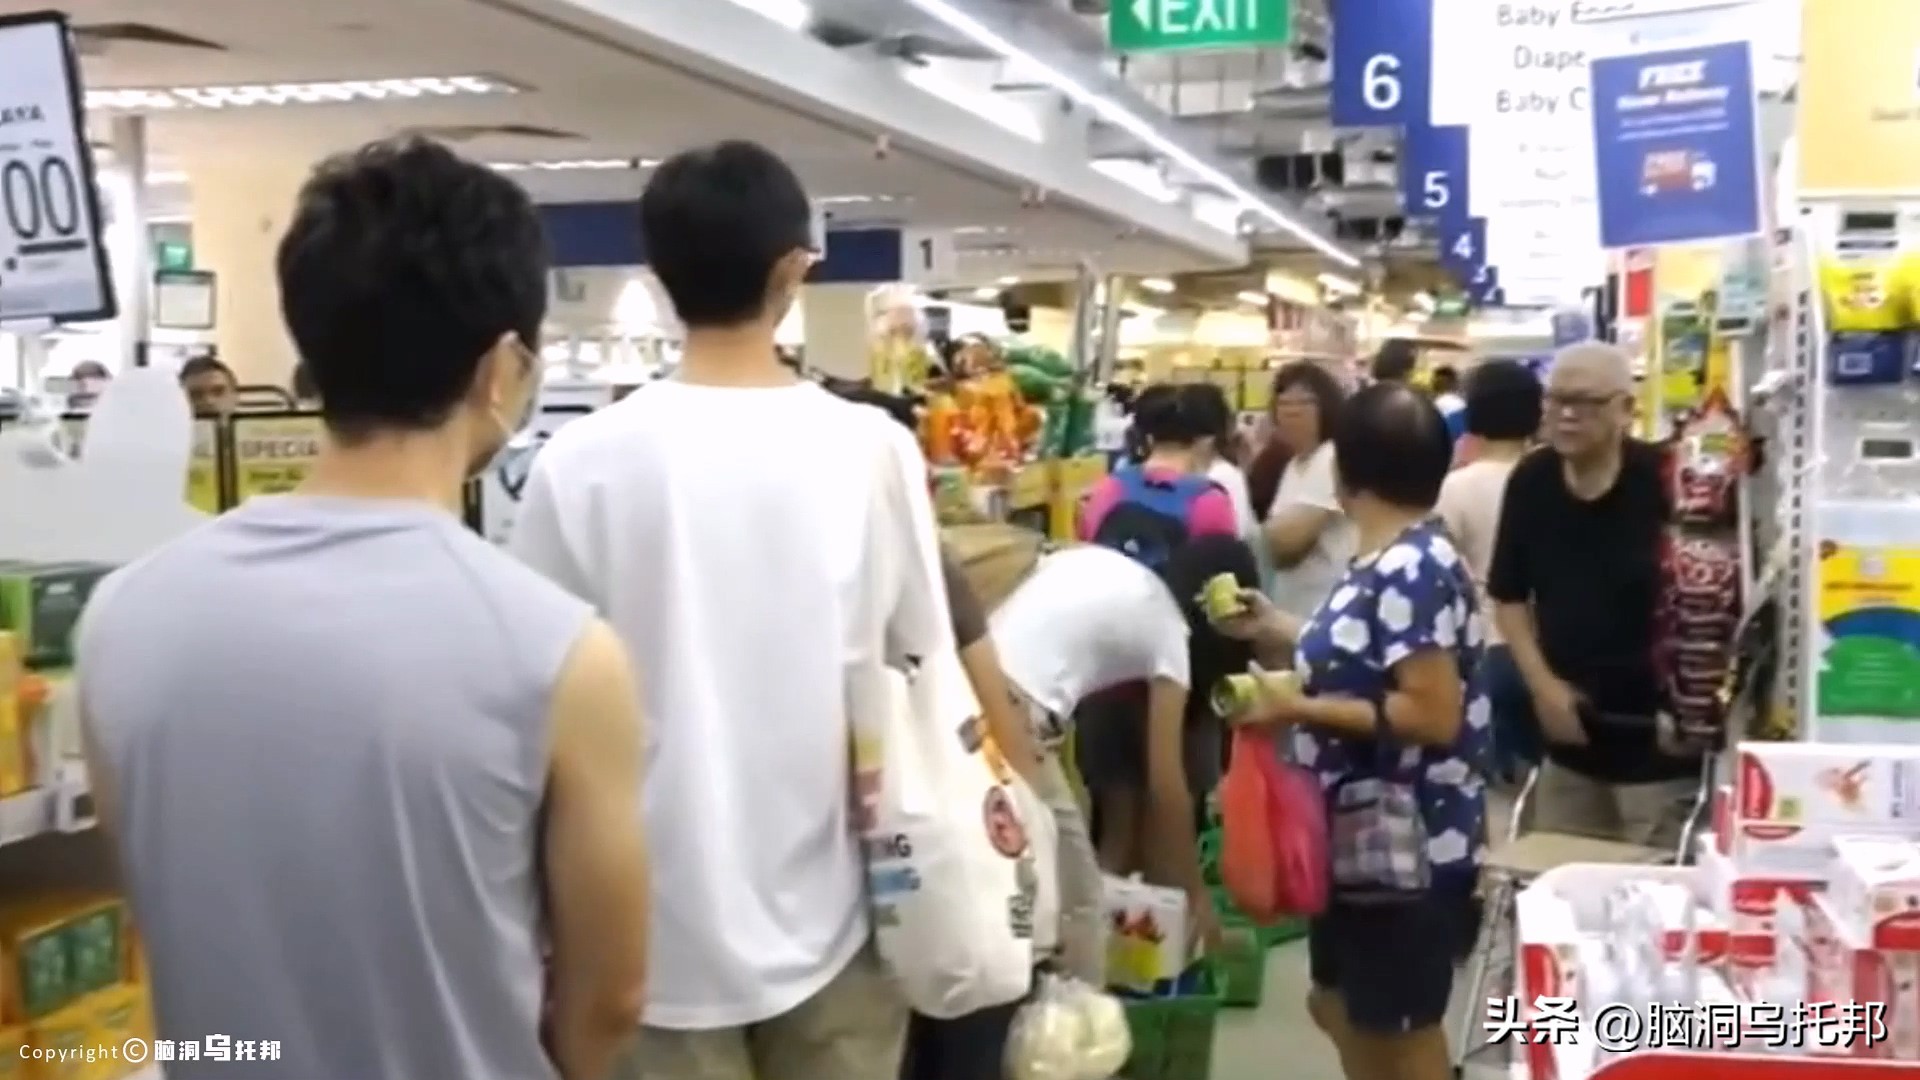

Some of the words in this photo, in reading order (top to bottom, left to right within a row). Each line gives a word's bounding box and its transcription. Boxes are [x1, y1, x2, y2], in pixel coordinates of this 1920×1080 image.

[1496, 3, 1560, 28] Baby
[1363, 53, 1401, 110] 6
[1496, 88, 1559, 115] Baby
[1423, 171, 1451, 208] 5
[919, 238, 933, 270] 1
[1453, 233, 1475, 258] 4
